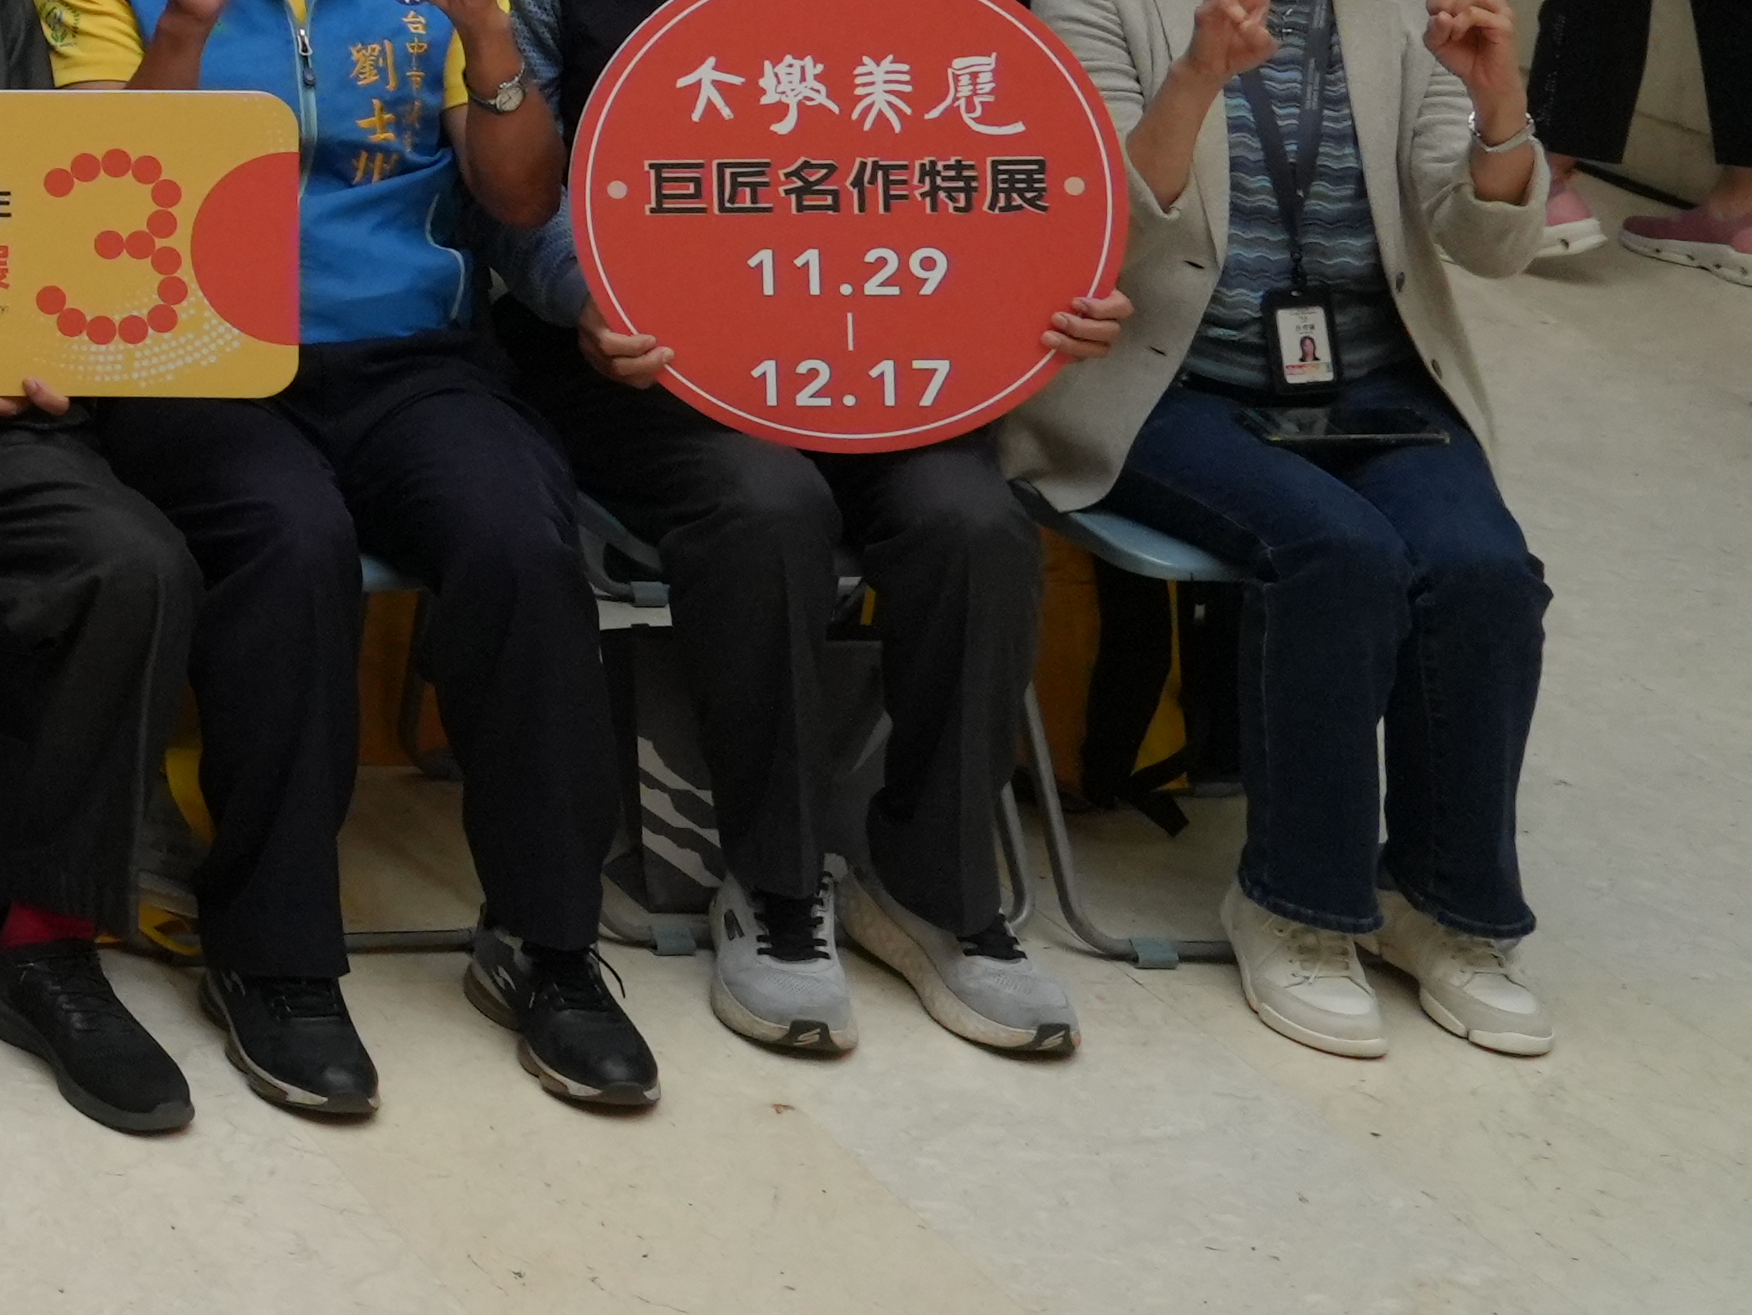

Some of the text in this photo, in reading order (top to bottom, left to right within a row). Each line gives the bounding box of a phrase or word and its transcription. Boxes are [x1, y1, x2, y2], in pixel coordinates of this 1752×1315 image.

[646, 156, 1050, 215] 巨匠名作特展
[747, 247, 949, 296] 11.29
[750, 359, 952, 407] 12.17
